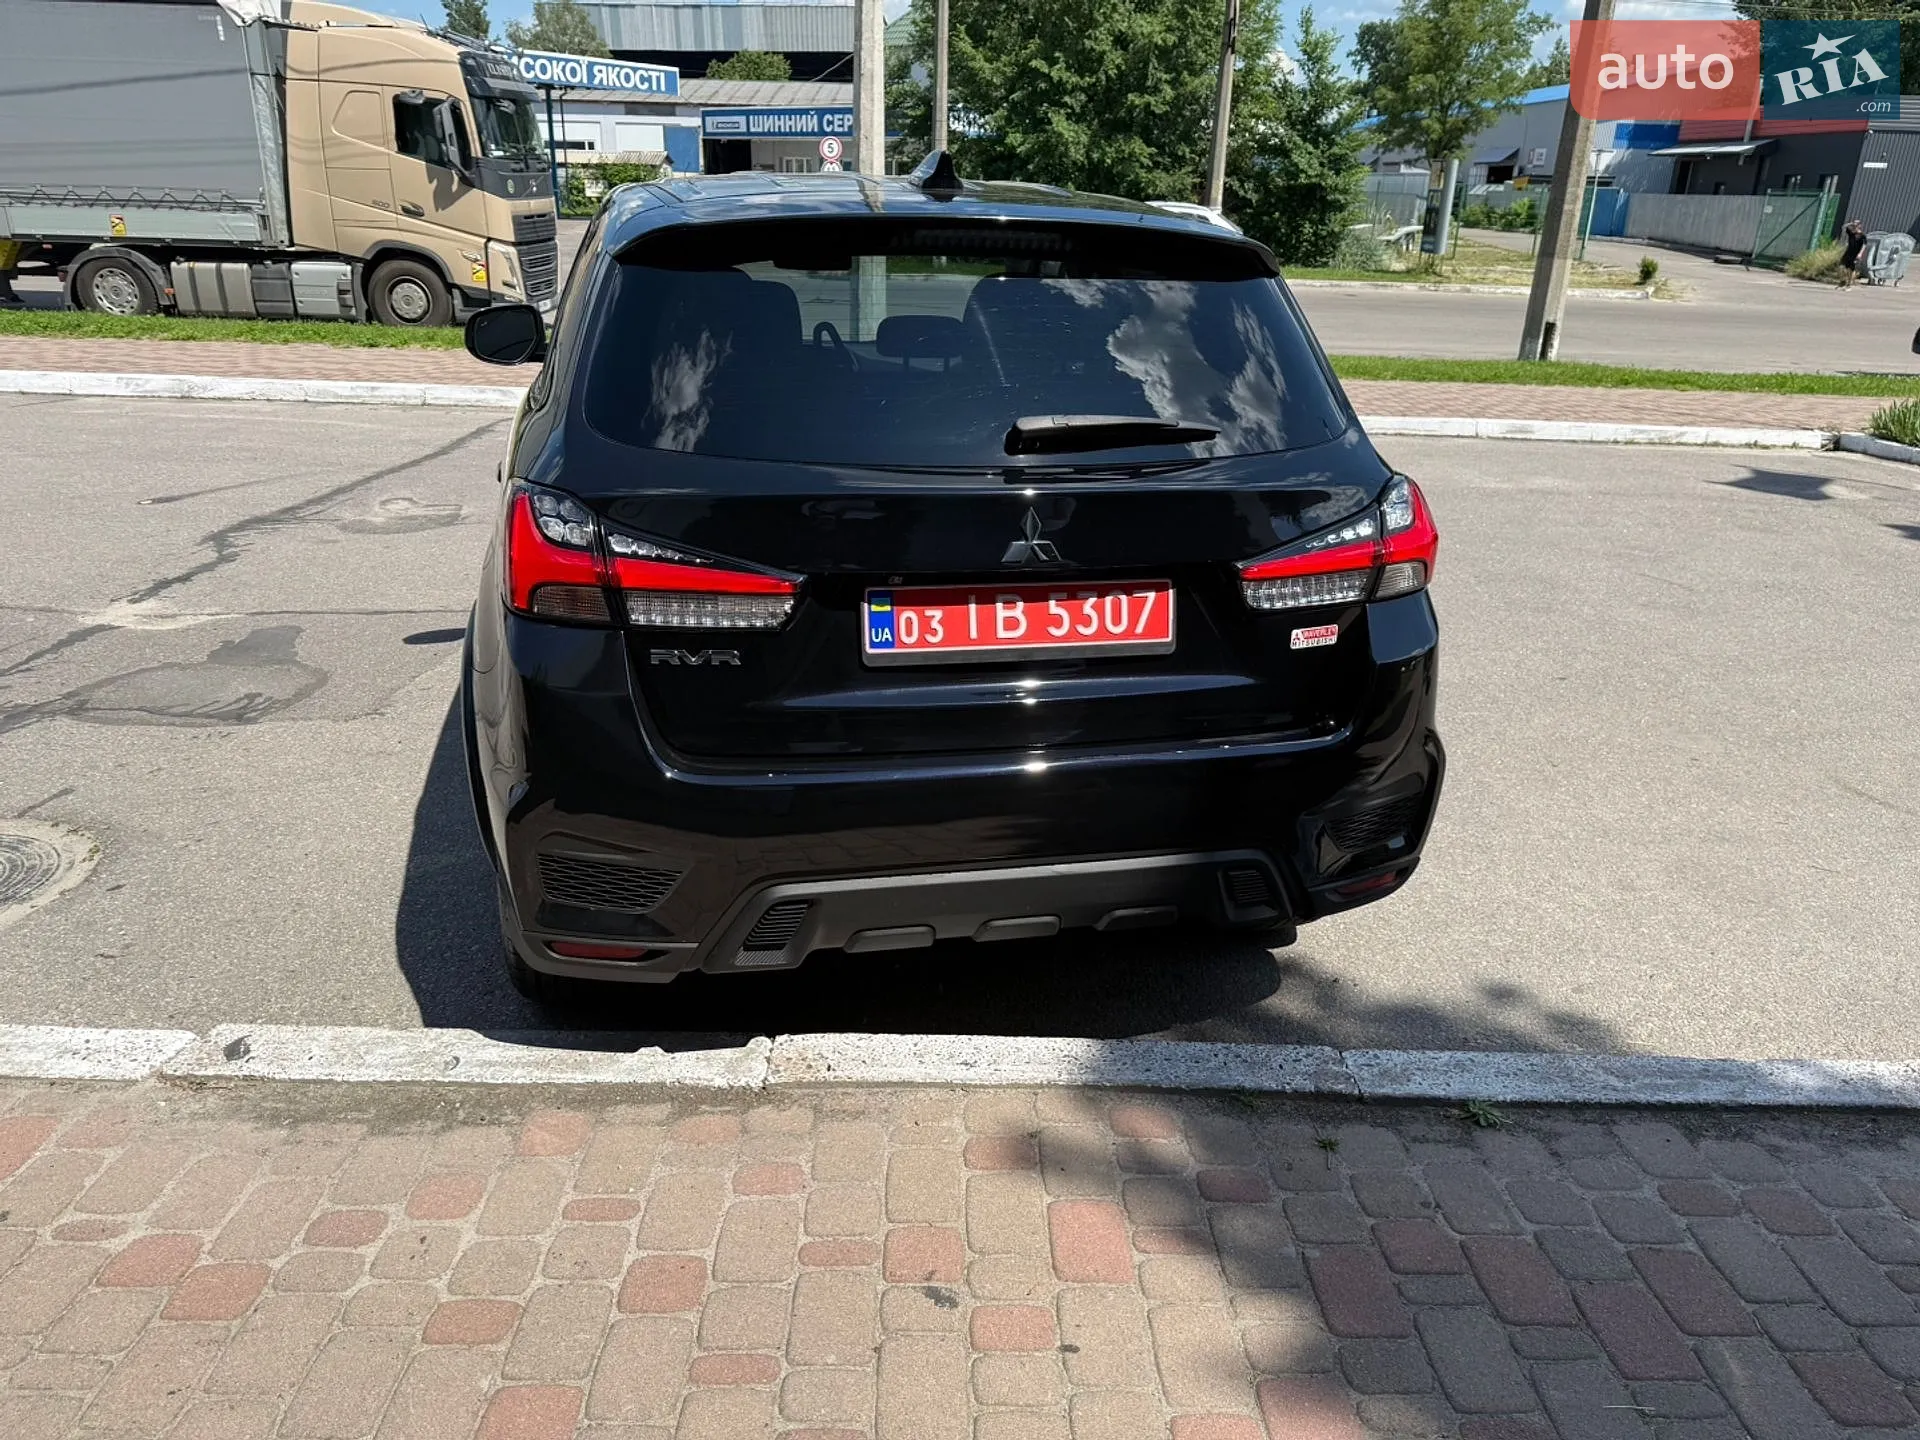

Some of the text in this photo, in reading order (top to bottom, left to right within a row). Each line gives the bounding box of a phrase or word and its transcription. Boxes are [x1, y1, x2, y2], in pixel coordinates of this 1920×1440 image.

[593, 65, 666, 92] ЯКОСТІ
[750, 111, 818, 133] ШИННИЙ
[827, 143, 834, 154] 5
[898, 609, 944, 645] 03
[1046, 590, 1156, 637] 5307
[871, 627, 893, 643] UA
[650, 649, 741, 665] RVR
